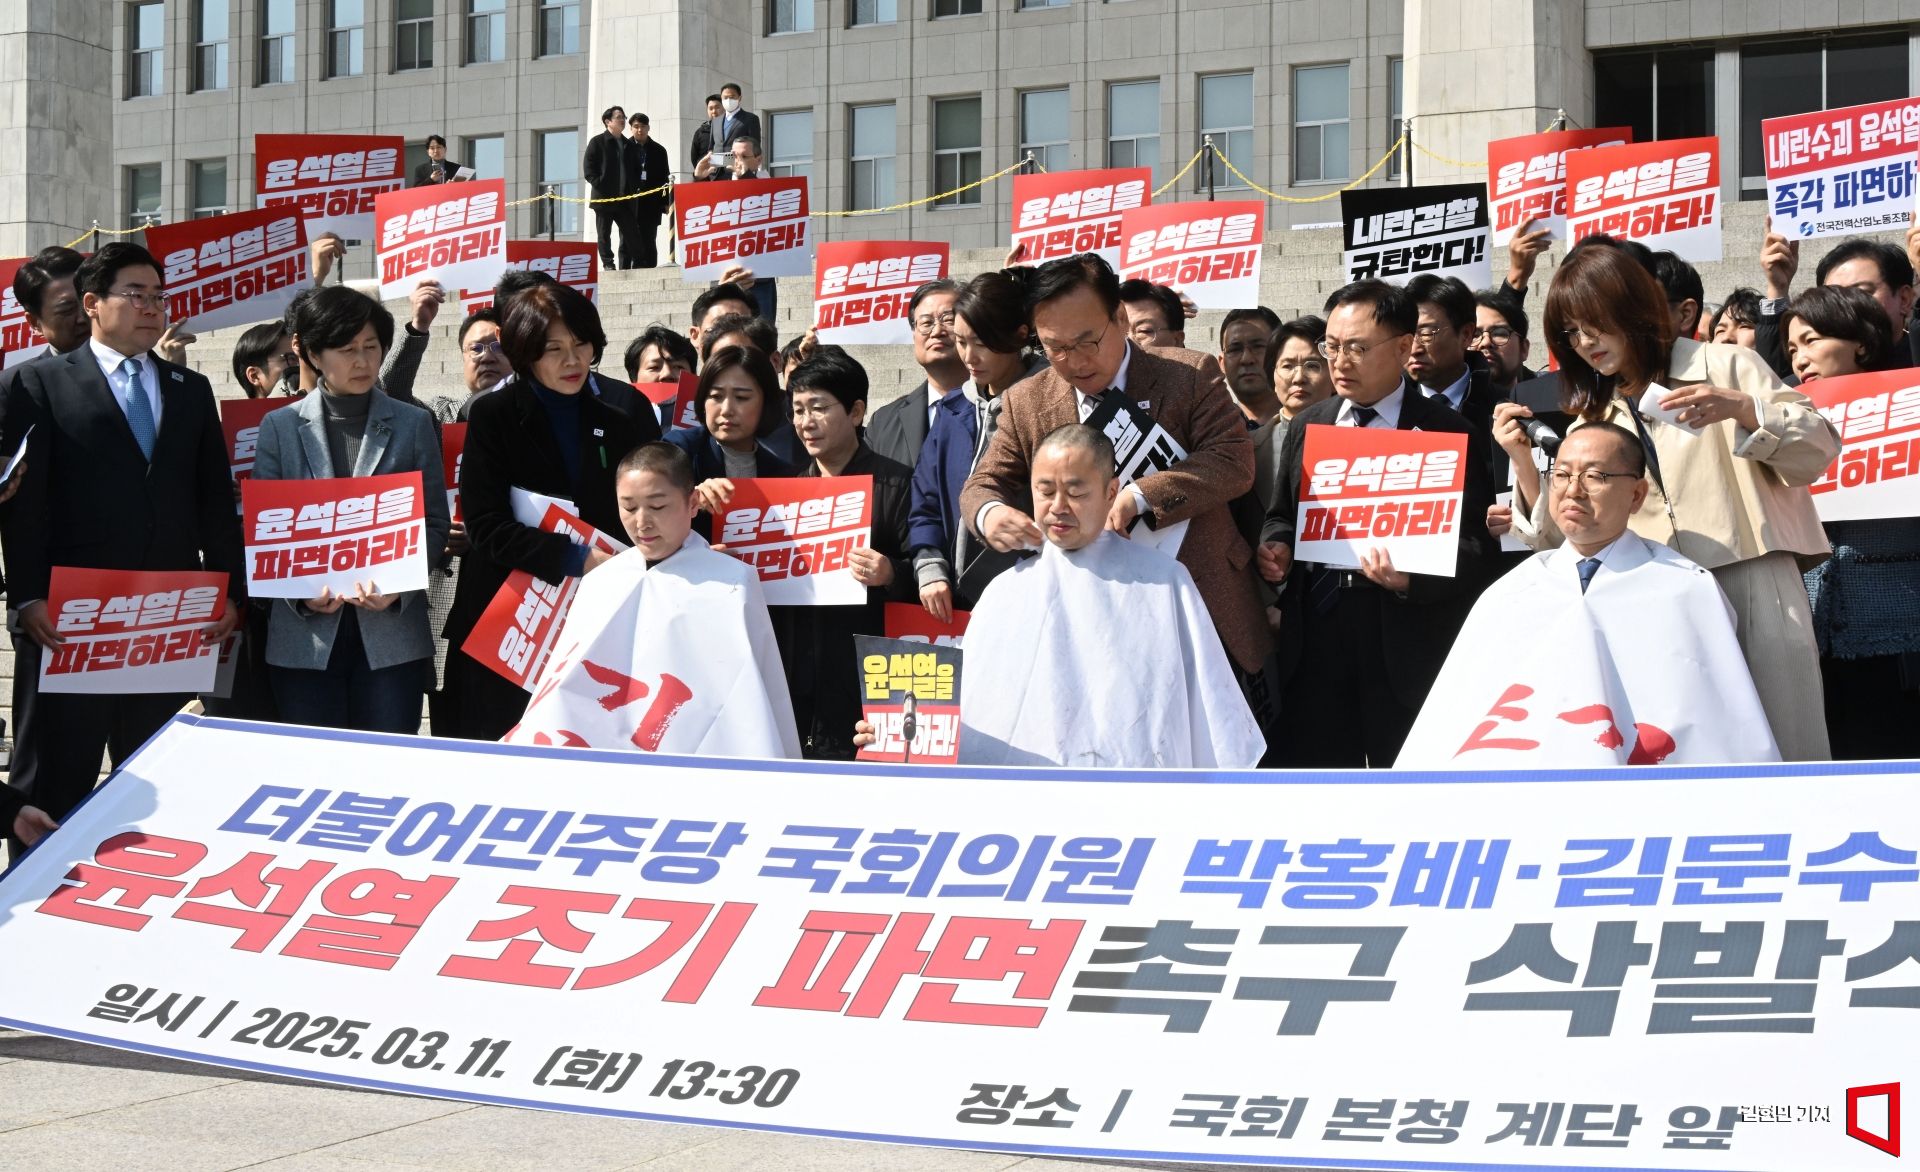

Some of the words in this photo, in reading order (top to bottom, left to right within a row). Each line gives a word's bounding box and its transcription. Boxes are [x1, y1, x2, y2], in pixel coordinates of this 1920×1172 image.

[264, 148, 398, 189] 윤석열을
[1768, 118, 1853, 169] 내란수괴
[1019, 179, 1146, 229] 윤석열을
[1572, 151, 1712, 213] 윤석열을
[1774, 177, 1825, 219] 즉각
[1833, 160, 1917, 209] 파면하
[383, 190, 500, 249] 윤석열을
[683, 187, 802, 233] 윤석열을
[1352, 197, 1480, 247] 내란검찰
[1816, 211, 1911, 233] 전국전력산업노동조합
[163, 216, 298, 285] 윤석열을
[381, 226, 501, 286] 파면하라!
[684, 220, 807, 270] 파면하라!
[1126, 212, 1257, 264] 윤석열을
[1350, 234, 1486, 281] 규탄한다!
[168, 251, 307, 324] 파면하라!
[820, 253, 943, 296] 윤석열을
[1307, 449, 1459, 497] 윤석열을
[254, 485, 415, 541] 윤석열을
[721, 490, 866, 543] 윤석열을
[1299, 498, 1459, 542] 파면하라!
[251, 524, 421, 581] 파면하라!
[55, 586, 220, 632] 윤석열을
[862, 653, 955, 700] 윤석열을
[859, 712, 956, 756] 파면하라!
[216, 783, 749, 884] 더불어민주당
[756, 823, 1157, 905] 국회의원
[34, 831, 460, 972] 윤석열
[436, 883, 759, 1004] 조기
[86, 983, 206, 1032] 일시
[532, 1045, 643, 1093] (화)
[648, 1058, 801, 1108] 13:30
[955, 1081, 1082, 1128] 장소
[1168, 1092, 1310, 1140] 국회
[1321, 1098, 1470, 1146] 본청
[1484, 1101, 1644, 1149] 계단
[1661, 1104, 1742, 1151] 앞
